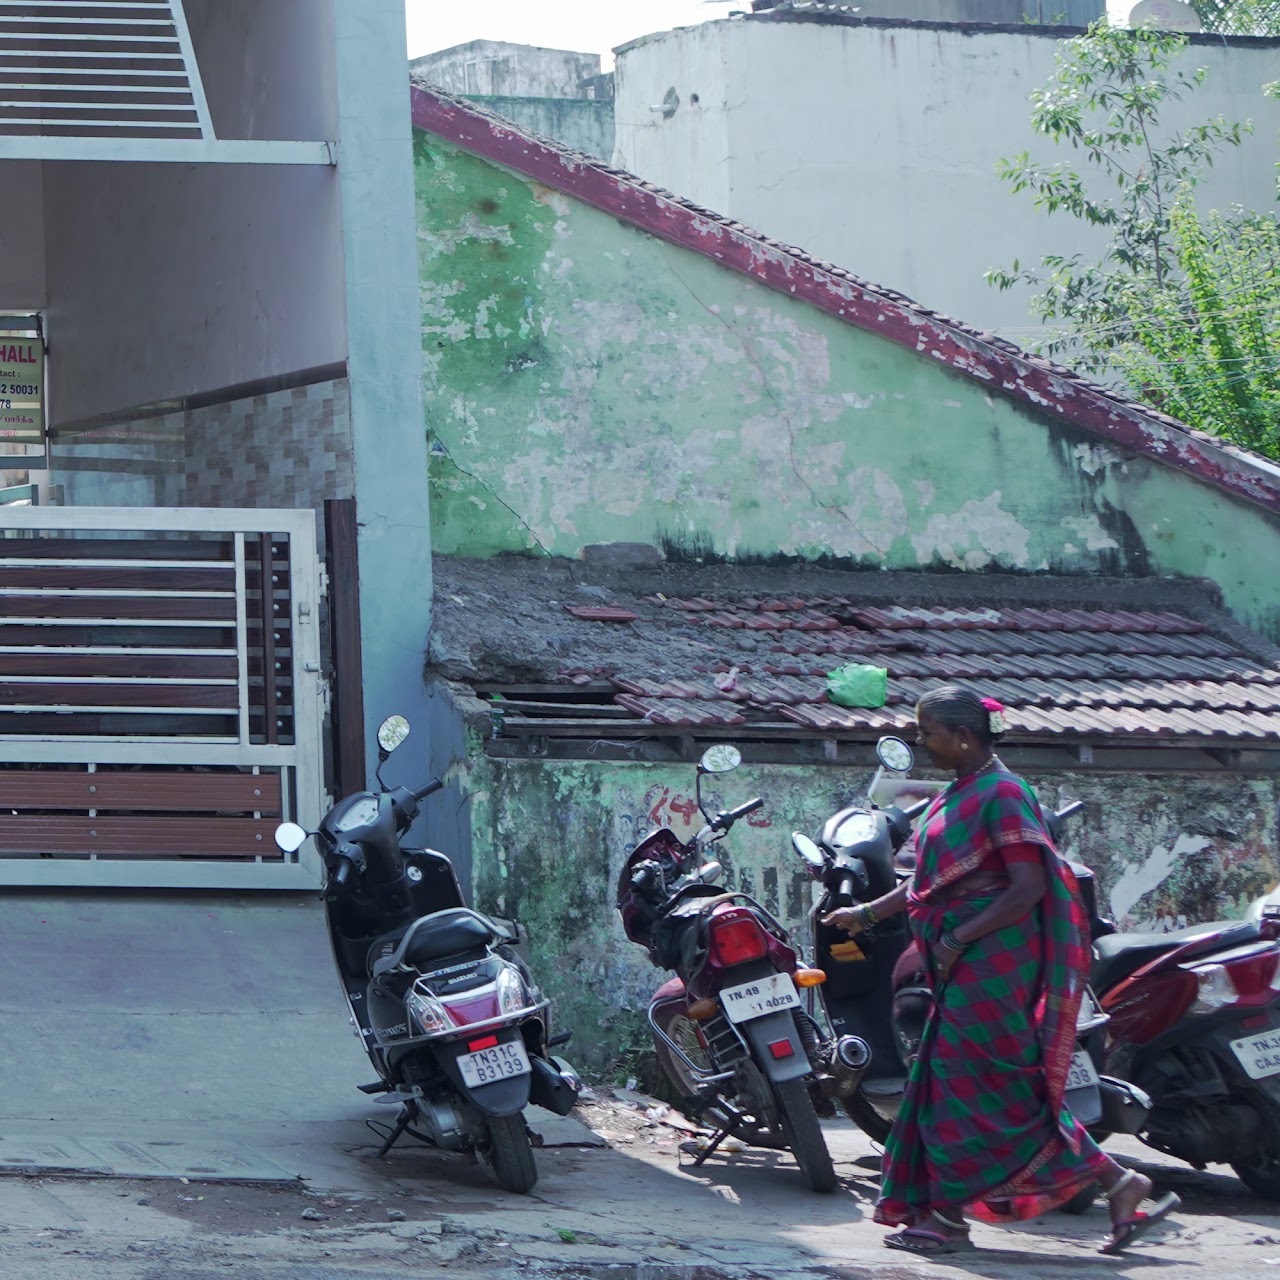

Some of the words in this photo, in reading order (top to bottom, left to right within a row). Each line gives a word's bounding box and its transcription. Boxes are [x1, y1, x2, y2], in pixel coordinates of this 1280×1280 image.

[9, 383, 39, 396] 50031
[470, 1044, 517, 1068] TN31C
[476, 1058, 524, 1082] B3139
